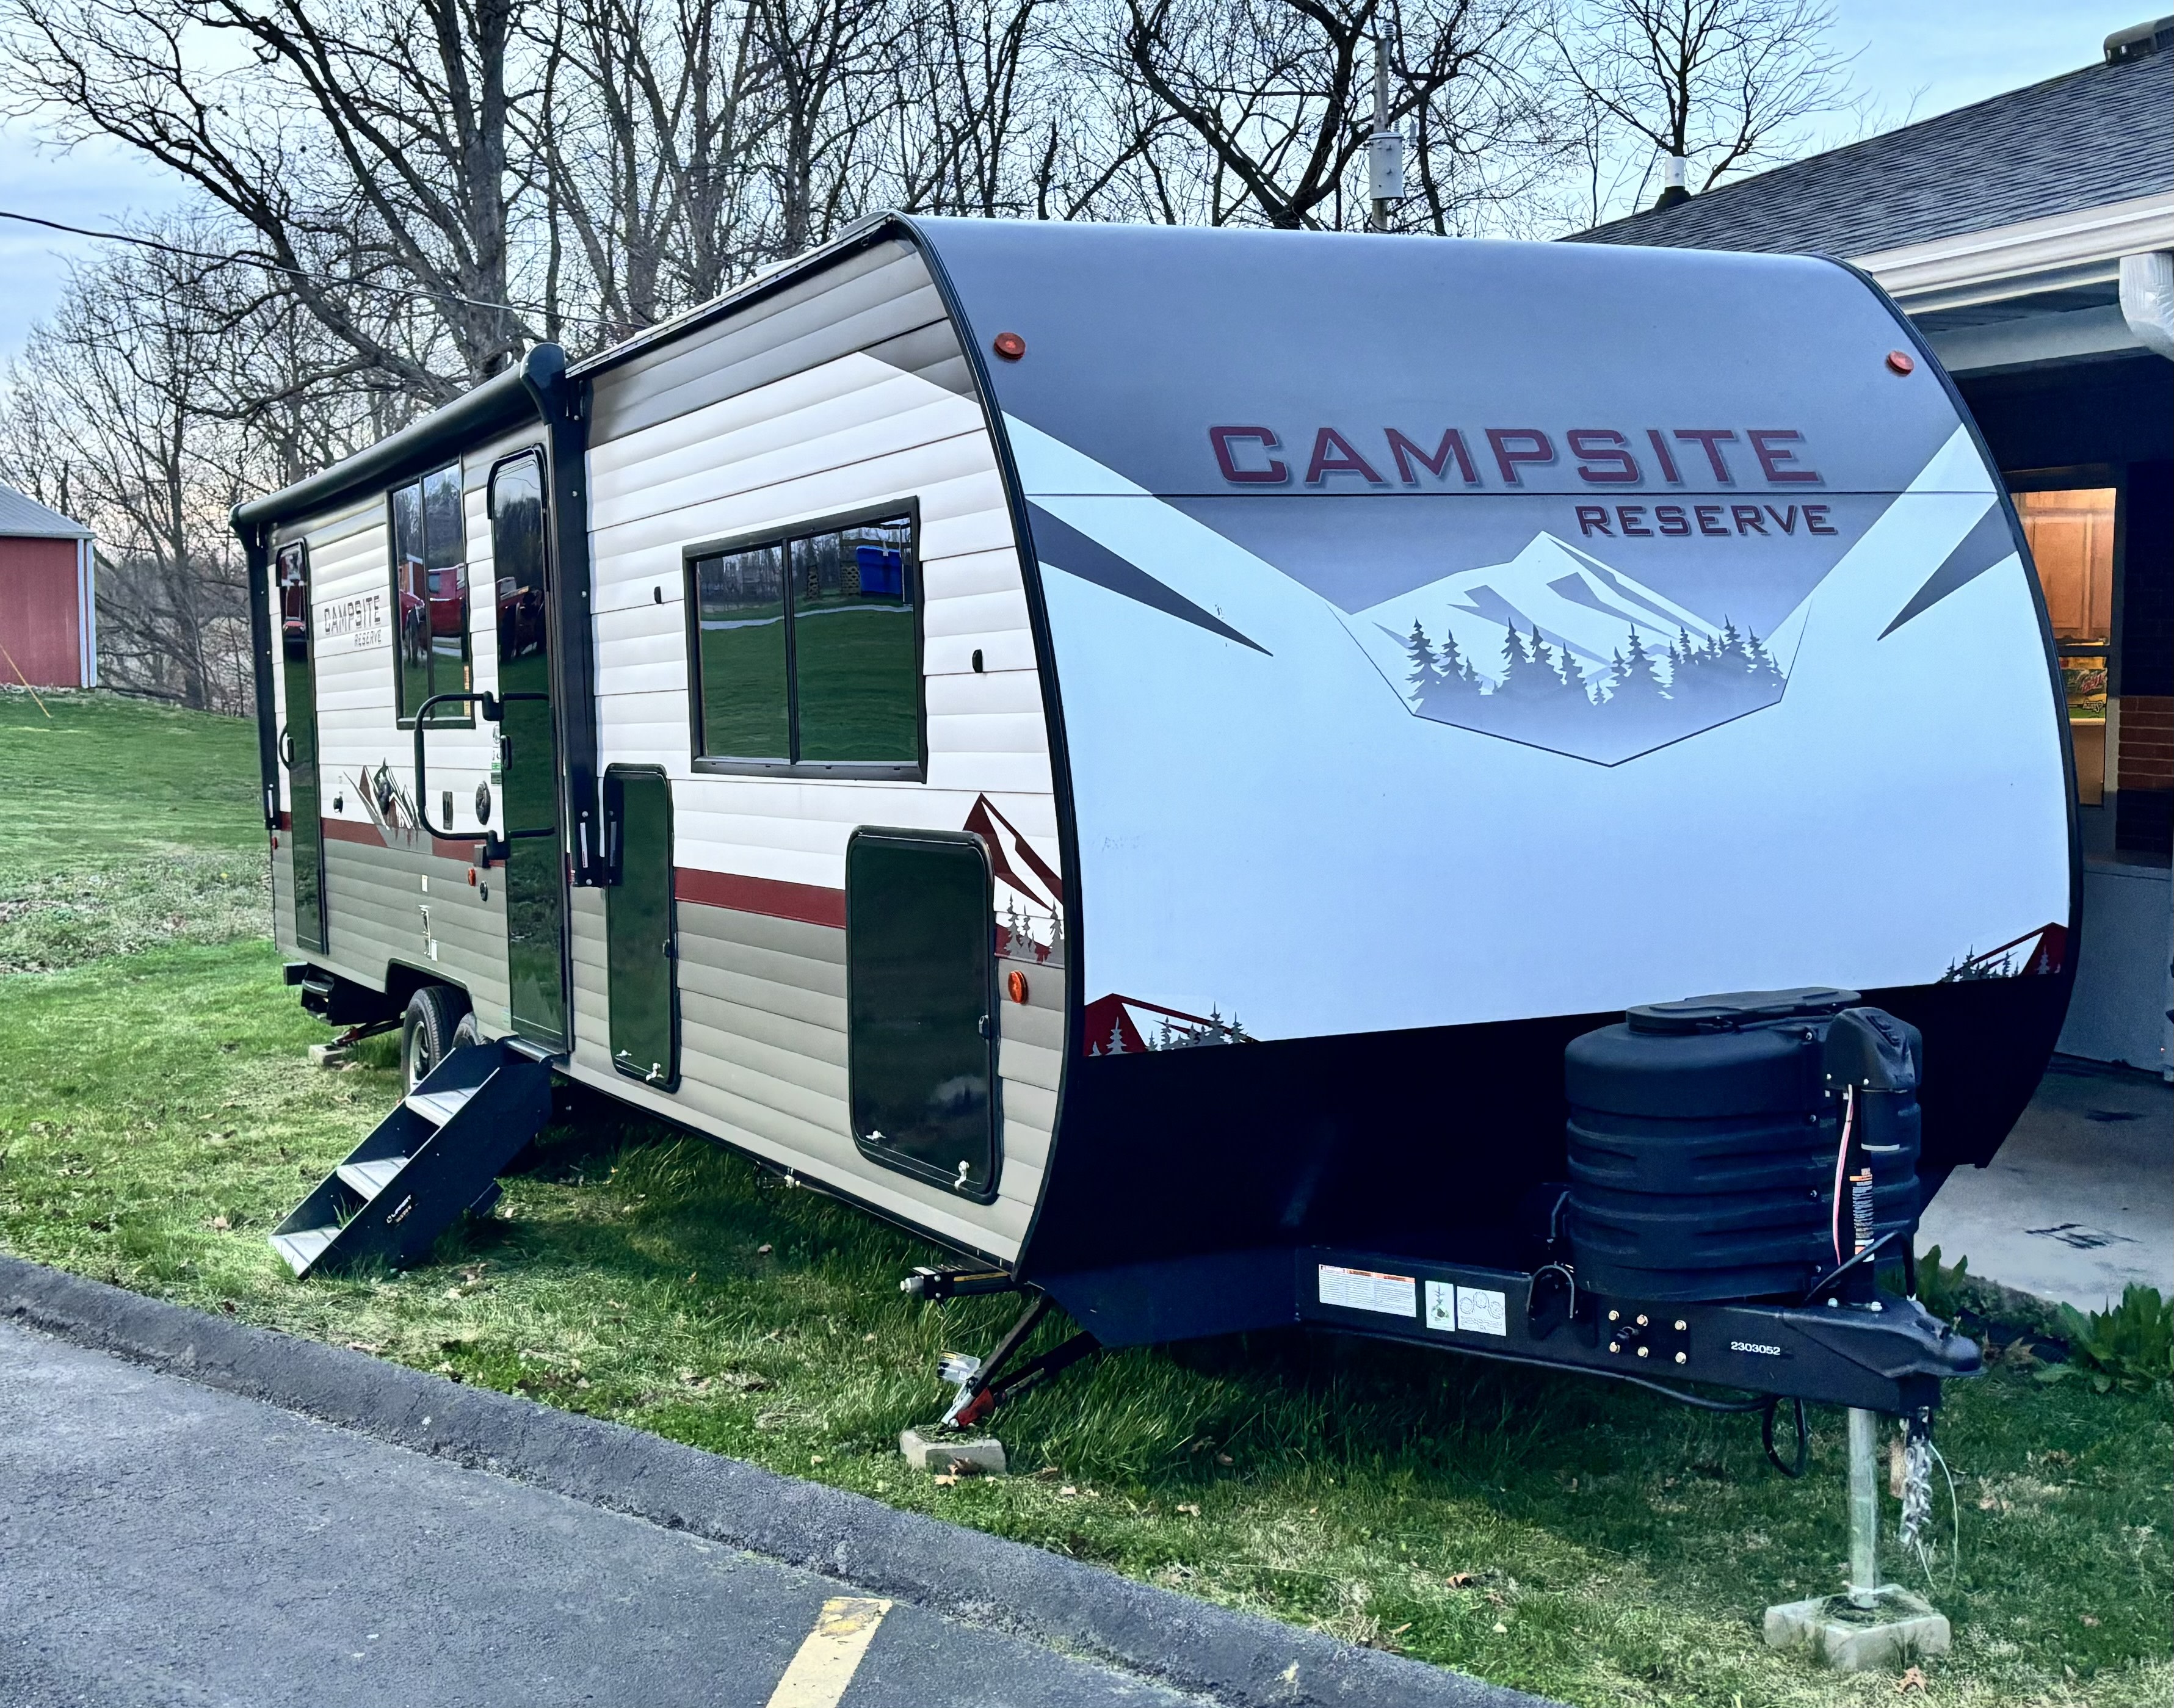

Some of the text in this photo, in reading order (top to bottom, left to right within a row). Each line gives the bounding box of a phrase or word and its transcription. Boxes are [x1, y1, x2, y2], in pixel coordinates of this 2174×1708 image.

[1209, 425, 1824, 485] CAMPSITE
[1574, 504, 1838, 537] RESERVE
[324, 595, 381, 635] CAMPSITE
[354, 629, 382, 647] RESERVE
[1731, 1341, 1781, 1355] 2303052
